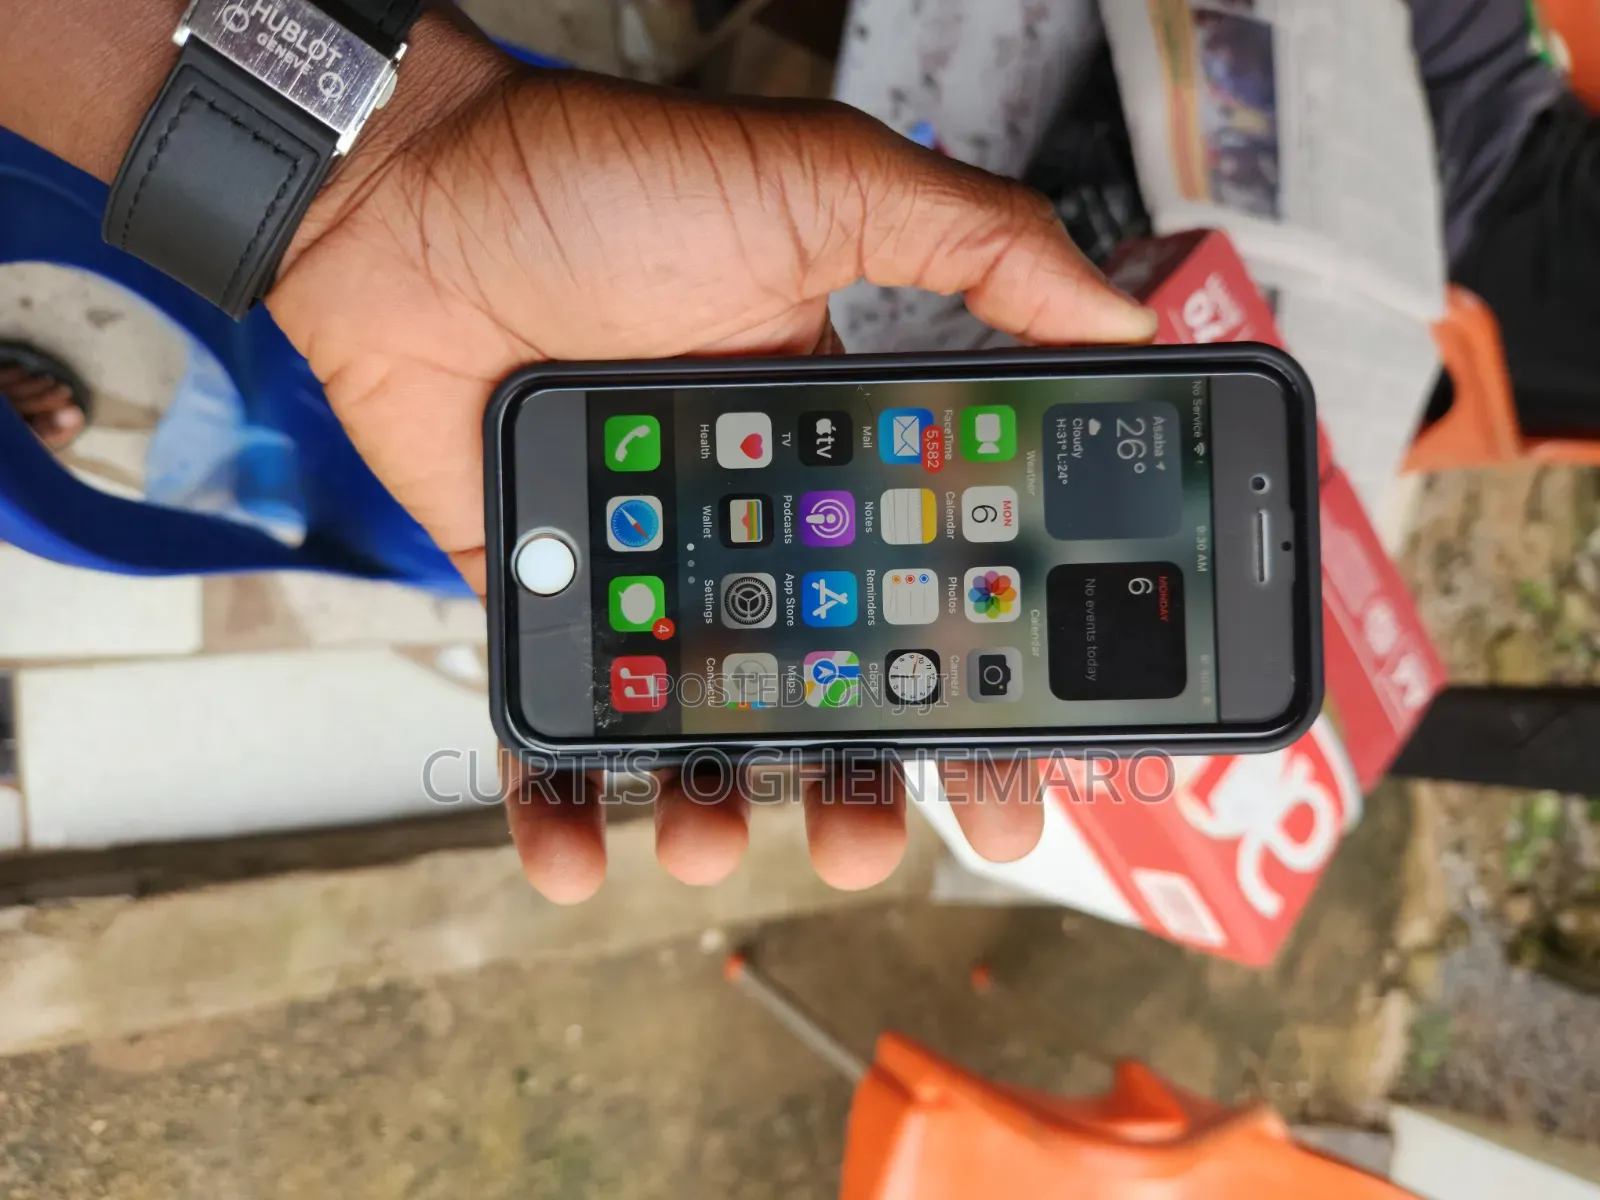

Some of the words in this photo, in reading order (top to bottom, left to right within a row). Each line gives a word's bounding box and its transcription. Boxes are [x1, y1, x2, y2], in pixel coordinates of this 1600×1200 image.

[250, 0, 343, 69] HUBLOT
[256, 32, 314, 76] GENEVE
[1192, 380, 1202, 396] No
[862, 426, 873, 448] Mail
[943, 409, 954, 460] FaceTime
[1152, 415, 1167, 457] Asaba
[1192, 399, 1203, 438] Service
[700, 424, 711, 460] Health
[782, 432, 792, 447] TV
[926, 430, 940, 468] 5,582
[1071, 418, 1084, 459] Cloudy
[1025, 450, 1037, 496] Weather
[702, 505, 713, 539] Wallet
[783, 495, 793, 544] Podcasts
[864, 501, 874, 533] Notes
[945, 491, 955, 540] Calendar
[971, 504, 998, 523] 6
[1003, 500, 1012, 527] MON
[1197, 554, 1208, 572] AM
[703, 579, 714, 624] Settings
[784, 573, 795, 595] App
[866, 569, 876, 626] Reminders
[948, 576, 958, 614] Photos
[1085, 578, 1096, 596] No
[1128, 577, 1153, 595] 6
[1158, 576, 1168, 622] MONDAY
[658, 624, 670, 634] 4
[785, 600, 796, 627] Store
[1085, 600, 1095, 642] events
[1030, 609, 1041, 657] Calendar
[787, 665, 797, 694] Maps
[868, 663, 879, 692] Clock
[949, 655, 960, 697] Camera
[1085, 645, 1099, 681] today
